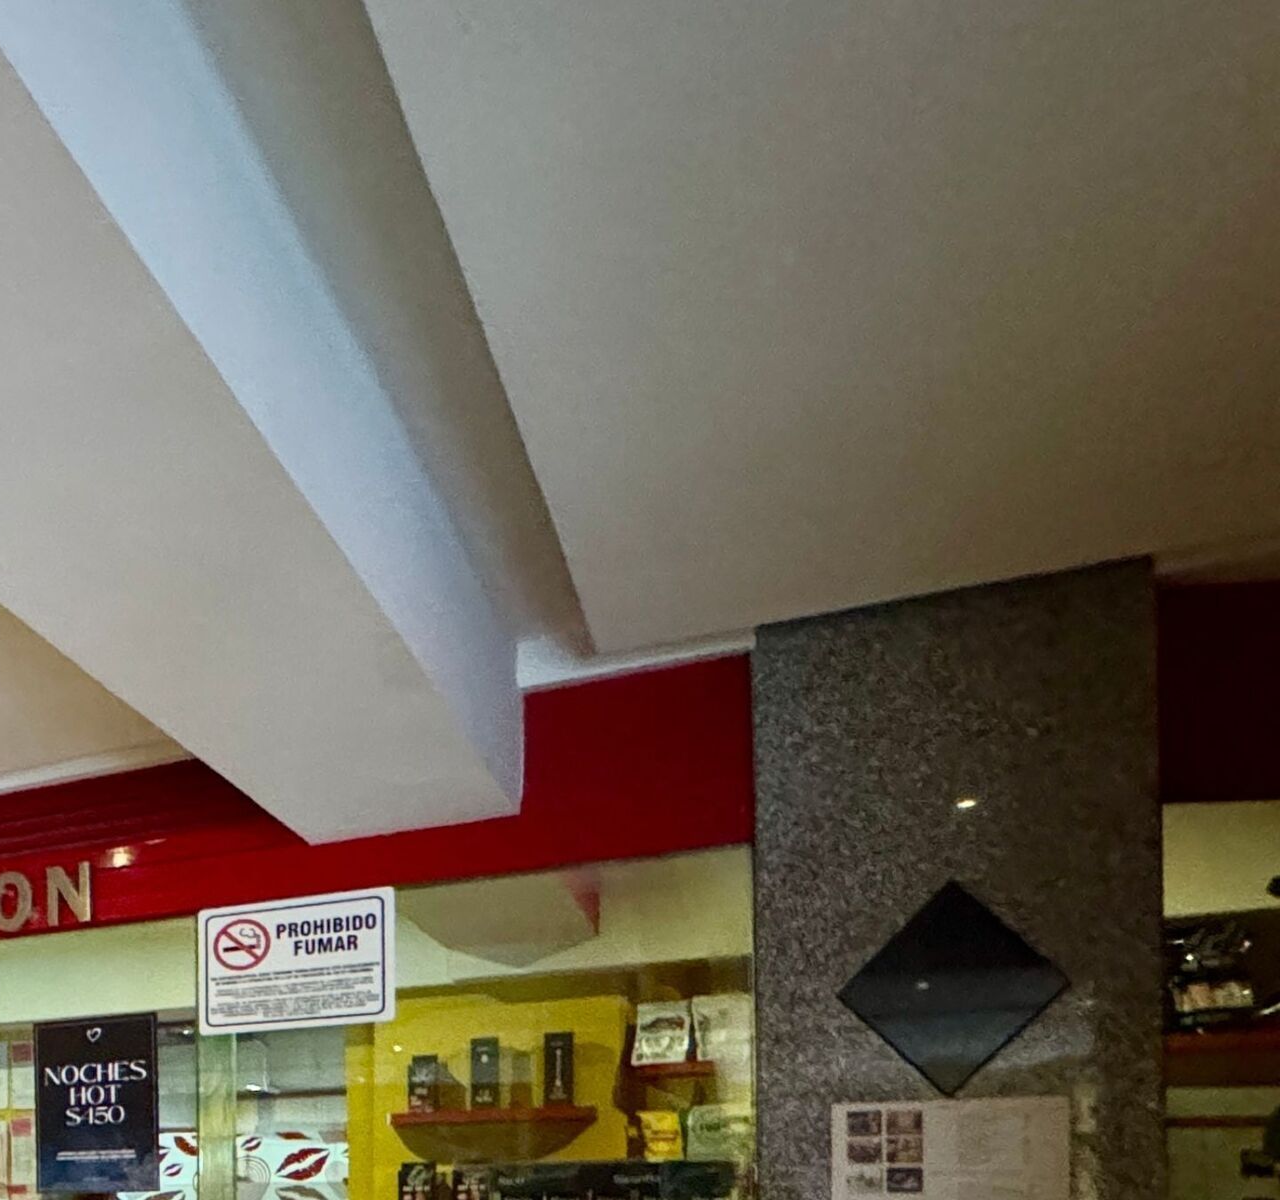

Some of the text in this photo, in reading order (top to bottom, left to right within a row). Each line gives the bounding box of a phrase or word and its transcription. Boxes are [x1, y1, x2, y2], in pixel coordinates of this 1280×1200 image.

[275, 912, 377, 939] PROHIBIDO
[293, 934, 358, 956] FUMAR
[44, 1060, 147, 1087] NOCHES
[69, 1084, 122, 1106] HOT
